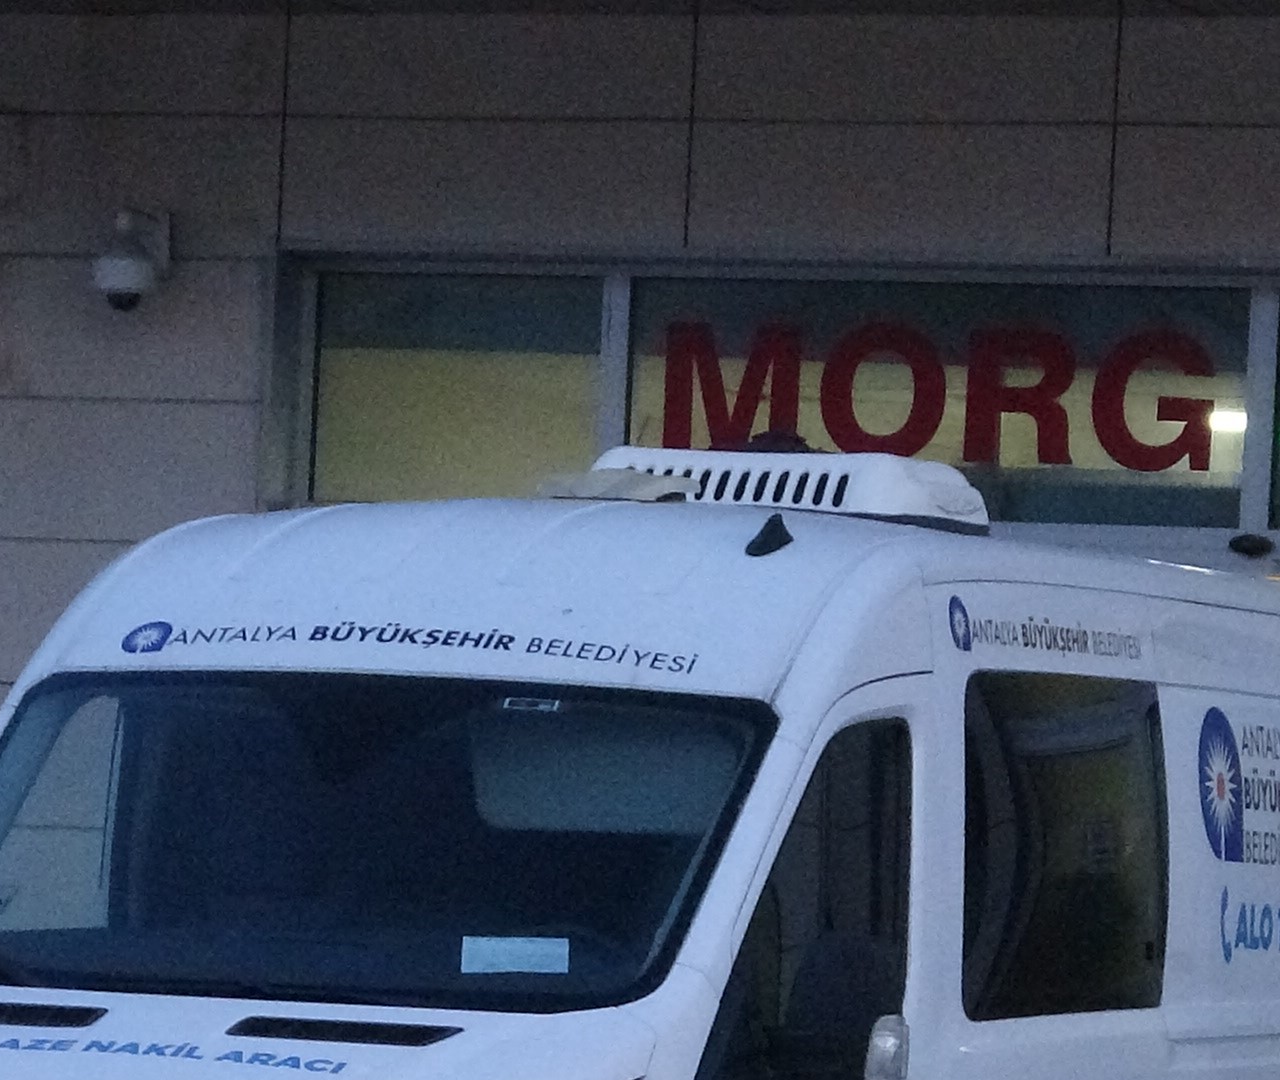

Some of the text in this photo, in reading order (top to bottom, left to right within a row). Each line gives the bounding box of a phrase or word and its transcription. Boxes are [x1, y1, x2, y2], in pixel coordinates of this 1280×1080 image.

[662, 320, 1215, 472] MORG
[170, 622, 700, 674] ANTALYA BÜYÜKŞEHİR BELEDİYESİ
[971, 619, 1020, 647] ANTALYA
[1021, 616, 1090, 657] BÜYÜKŞEHİR
[1234, 903, 1273, 950] ALO
[81, 1040, 206, 1060] NAKİL
[213, 1049, 348, 1075] ARACI
